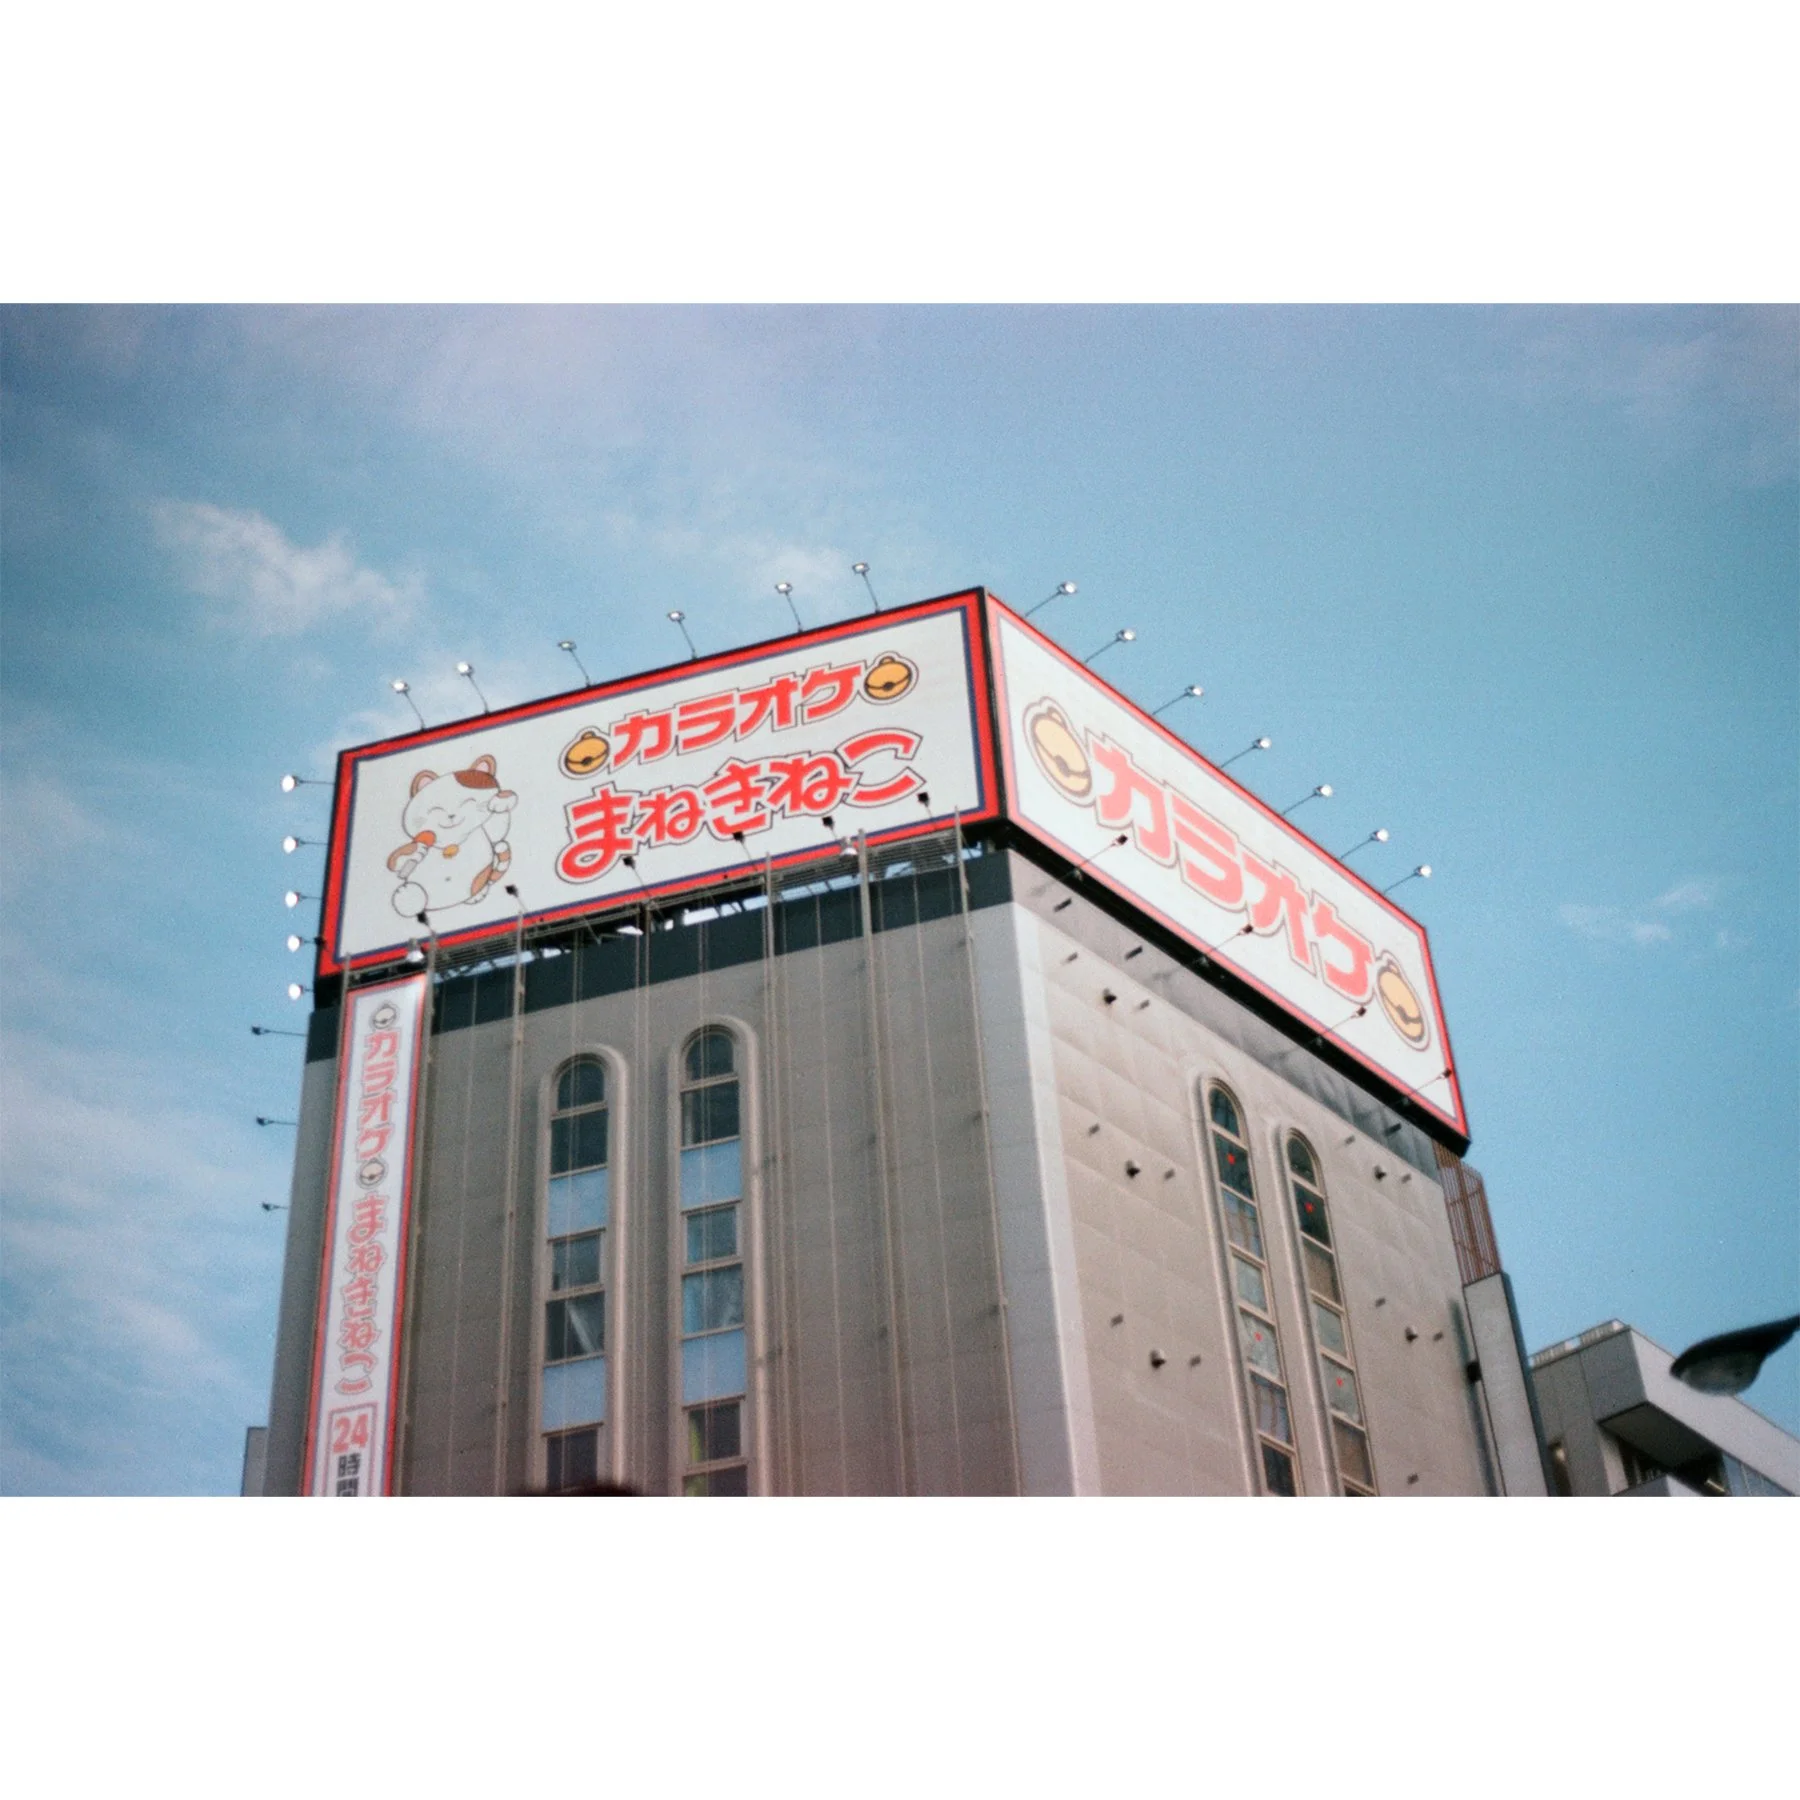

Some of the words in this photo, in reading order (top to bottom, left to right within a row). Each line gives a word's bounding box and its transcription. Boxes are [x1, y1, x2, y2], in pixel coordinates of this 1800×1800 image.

[610, 662, 865, 773] カラオケ
[558, 730, 922, 881] まねきねこ
[1088, 733, 1374, 1002] カラオケ
[358, 1029, 399, 1161] カラオケ
[338, 1192, 386, 1394] まねきねこ
